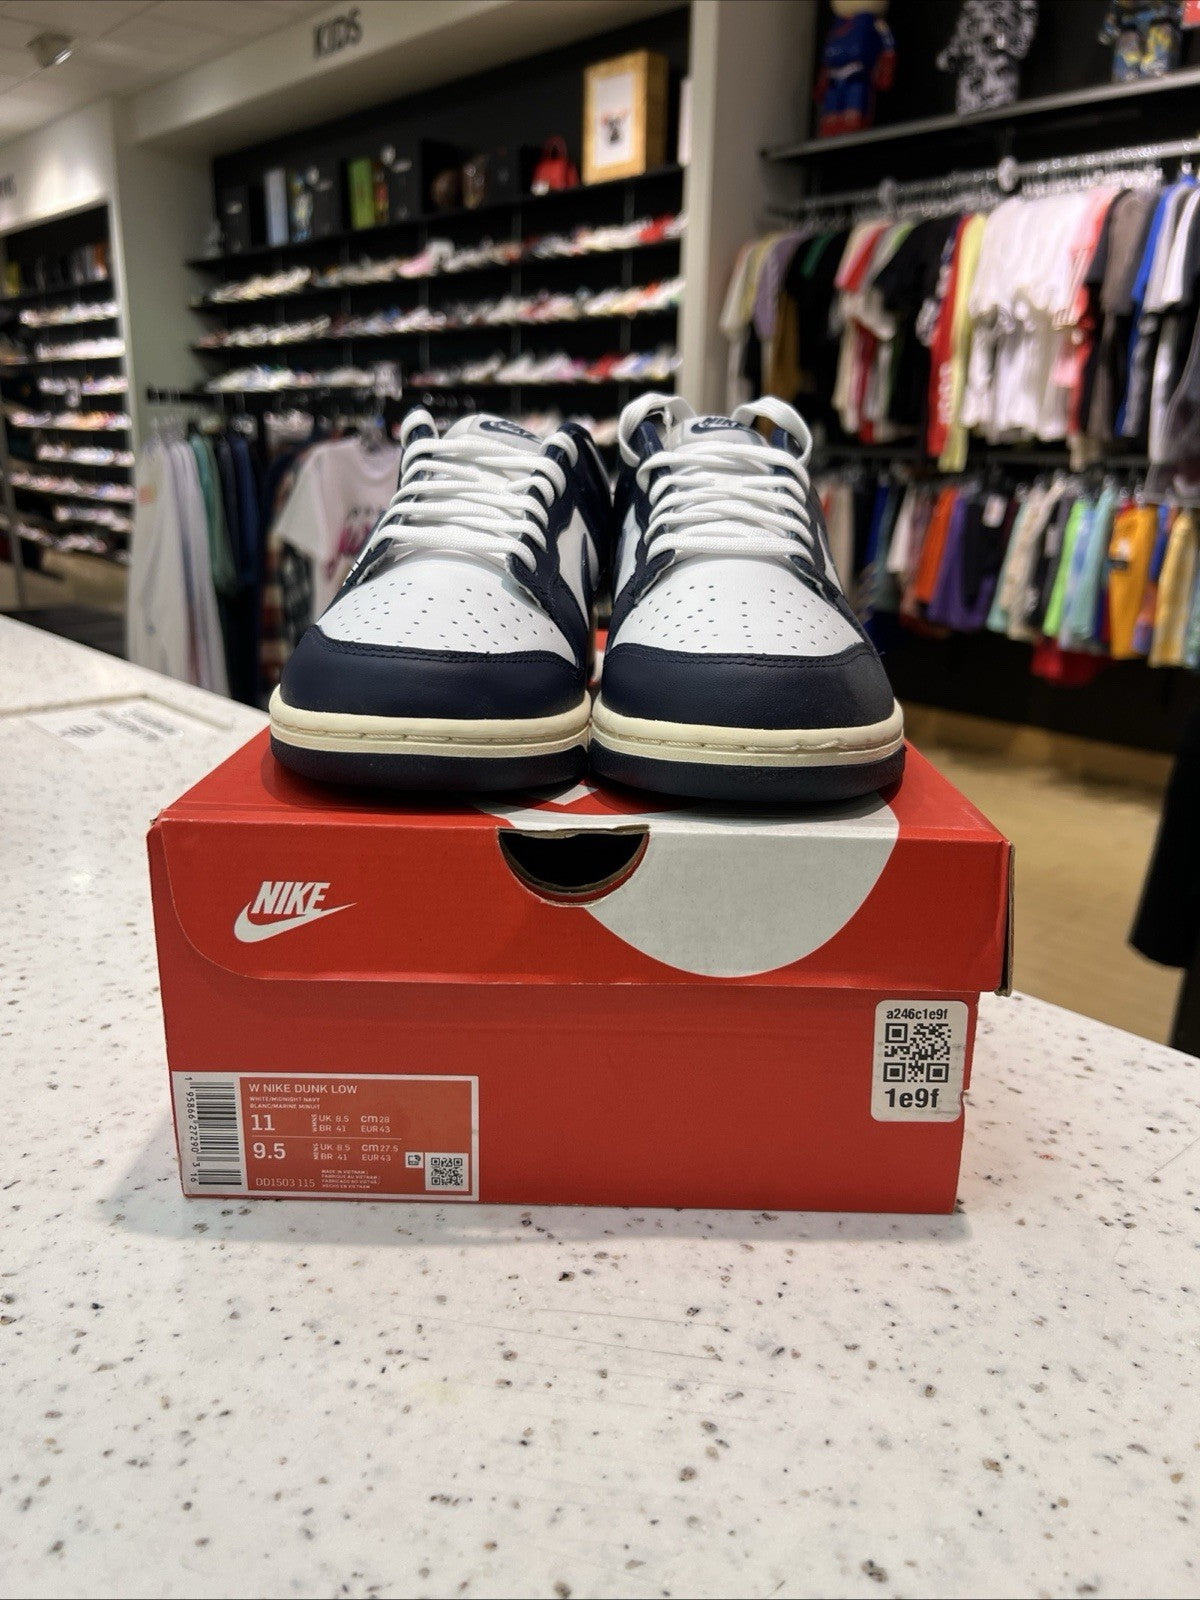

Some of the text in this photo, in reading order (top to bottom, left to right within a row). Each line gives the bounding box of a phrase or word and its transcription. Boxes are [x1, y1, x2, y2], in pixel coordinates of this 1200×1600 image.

[312, 7, 362, 59] KIDS
[251, 881, 331, 915] NIKE
[886, 1008, 949, 1020] a246c1e9f
[248, 1083, 358, 1094] W NIKE DUNK LOW
[186, 1091, 198, 1120] 95866
[884, 1088, 940, 1108] 1e9f
[250, 1114, 275, 1131] 11
[335, 1115, 350, 1123] 8.5
[189, 1125, 200, 1153] 27290
[253, 1142, 286, 1159] 9.5
[336, 1144, 351, 1152] 8.5
[256, 1178, 316, 1188] DD1503 115
